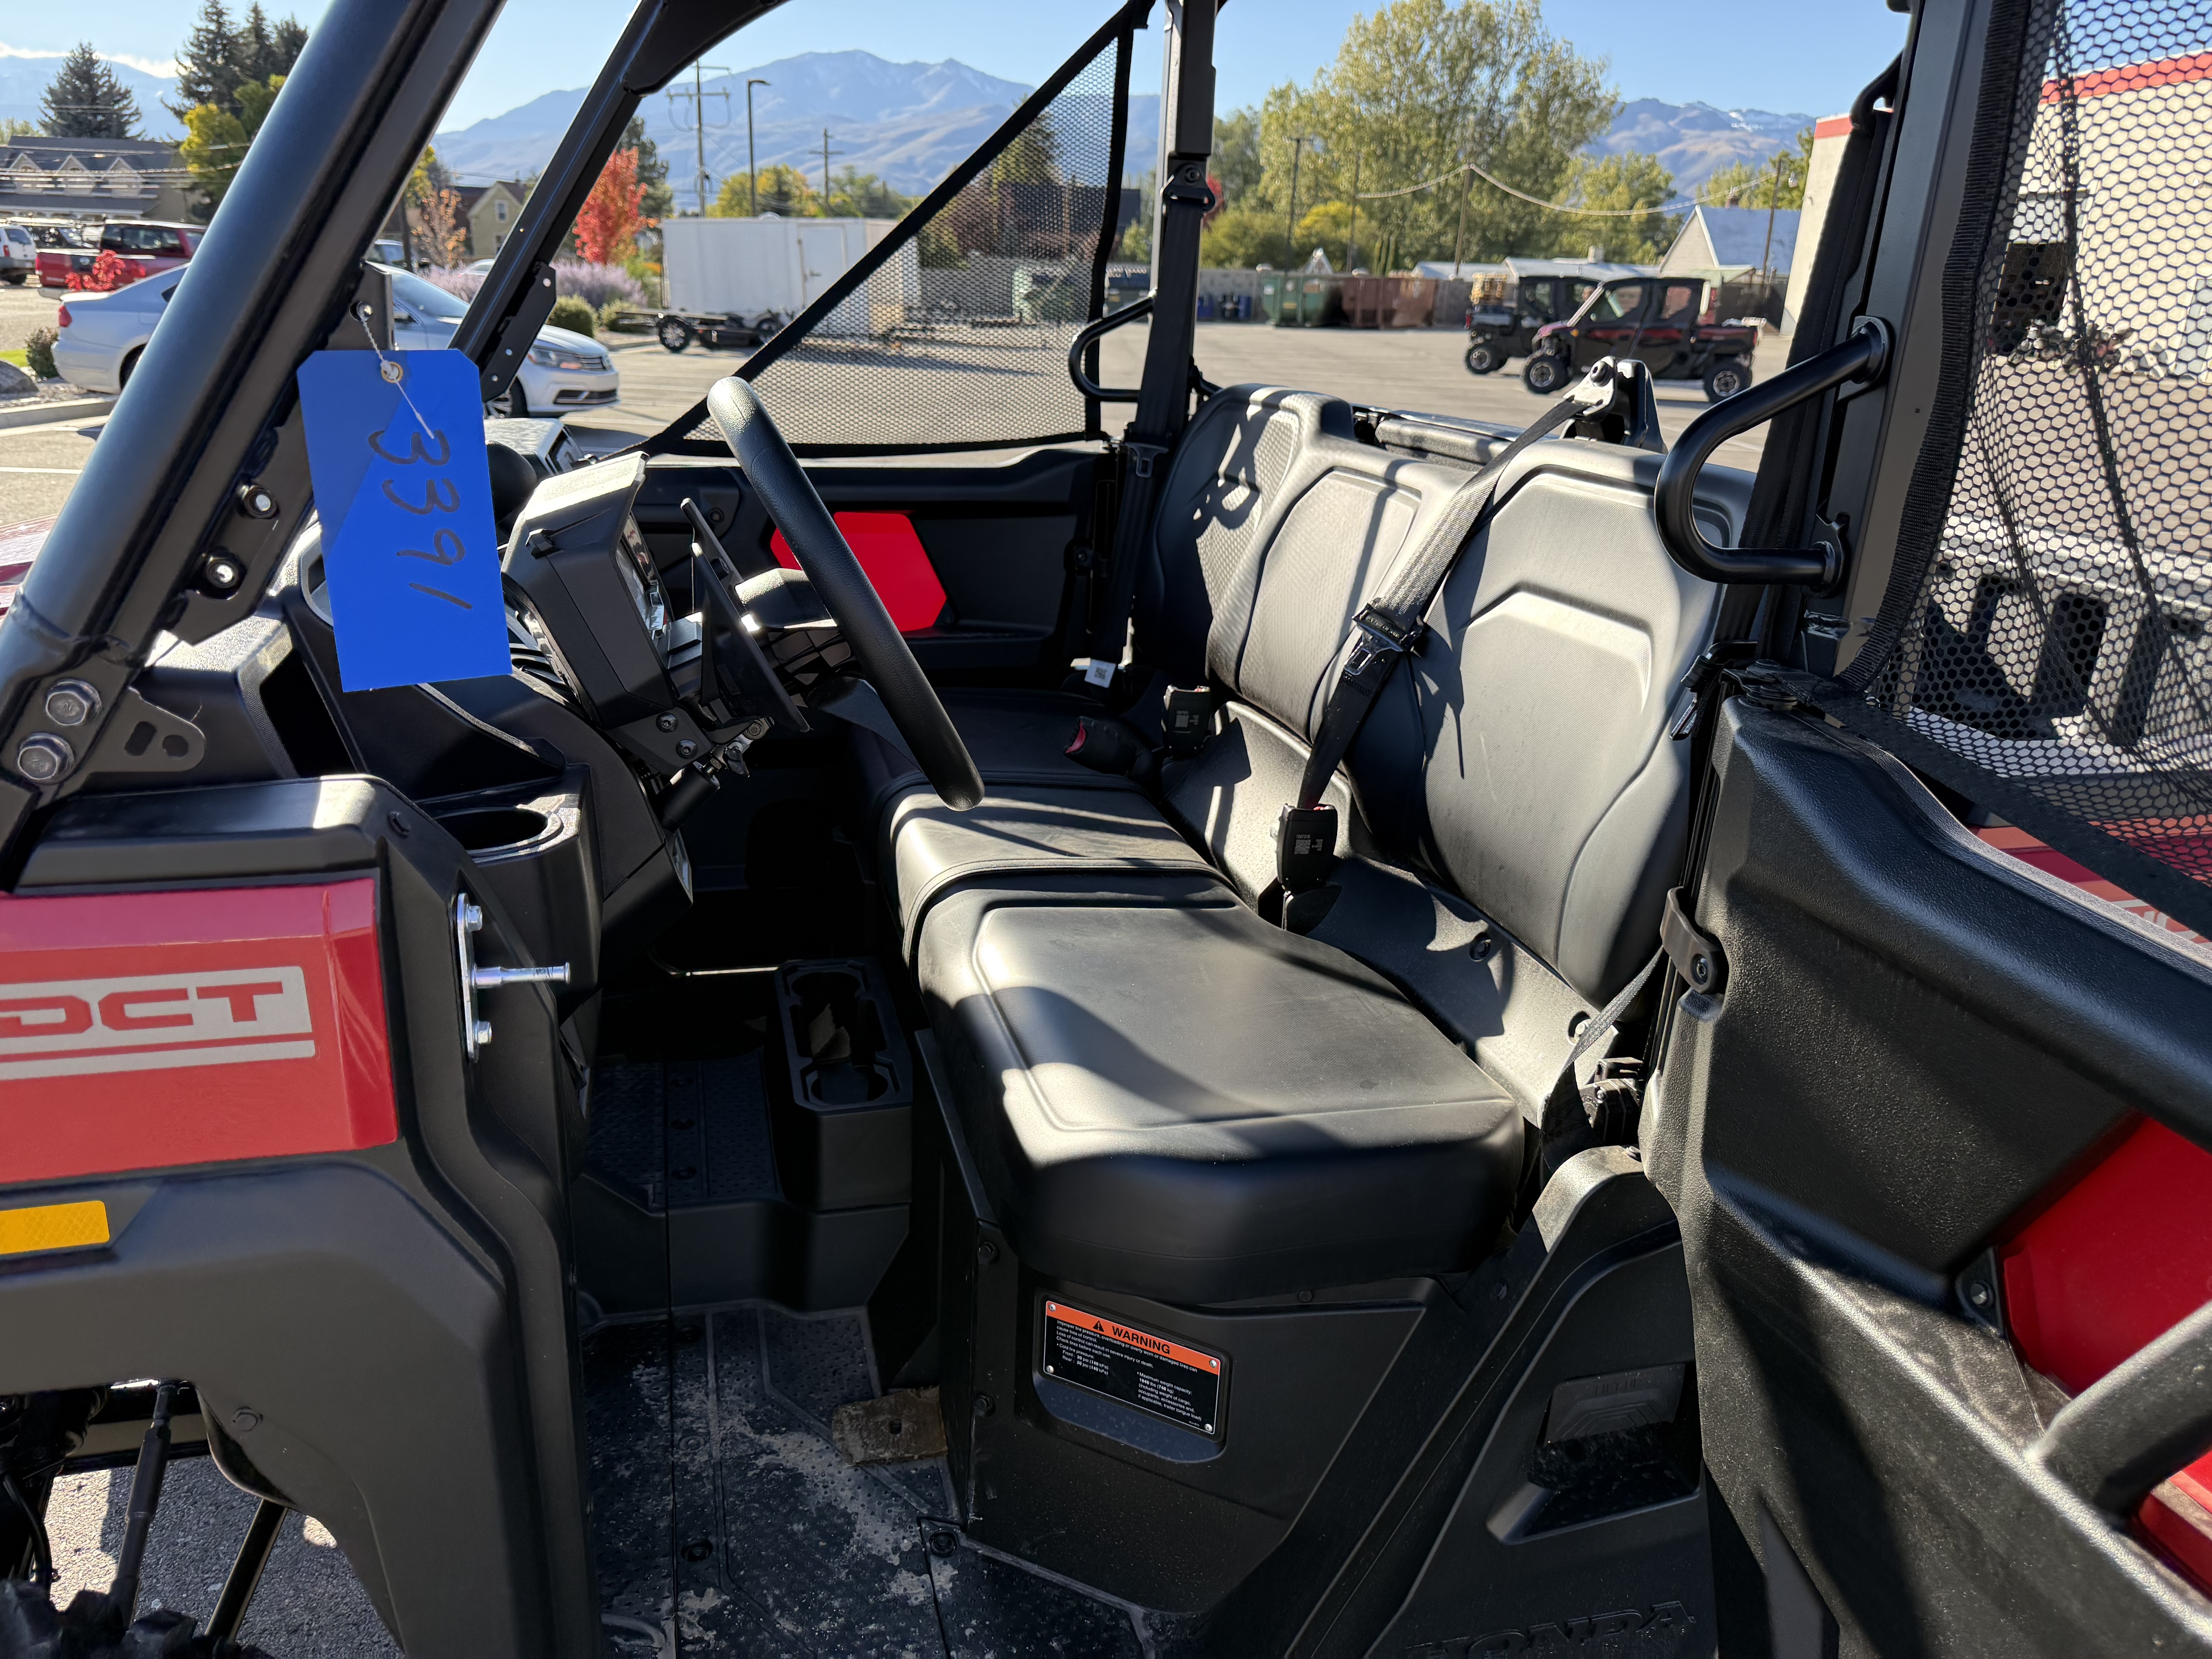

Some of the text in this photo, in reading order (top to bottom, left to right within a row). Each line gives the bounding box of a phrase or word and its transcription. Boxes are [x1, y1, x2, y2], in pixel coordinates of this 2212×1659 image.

[368, 429, 472, 609] 3391
[0, 981, 283, 1038] DCT
[1057, 1320, 1074, 1329] Improper
[1101, 1336, 1125, 1347] overloading
[1159, 1356, 1178, 1365] damaged
[1112, 1326, 1170, 1355] WARNING
[1139, 1372, 1159, 1382] Maximum
[1161, 1397, 1185, 1408] accessories
